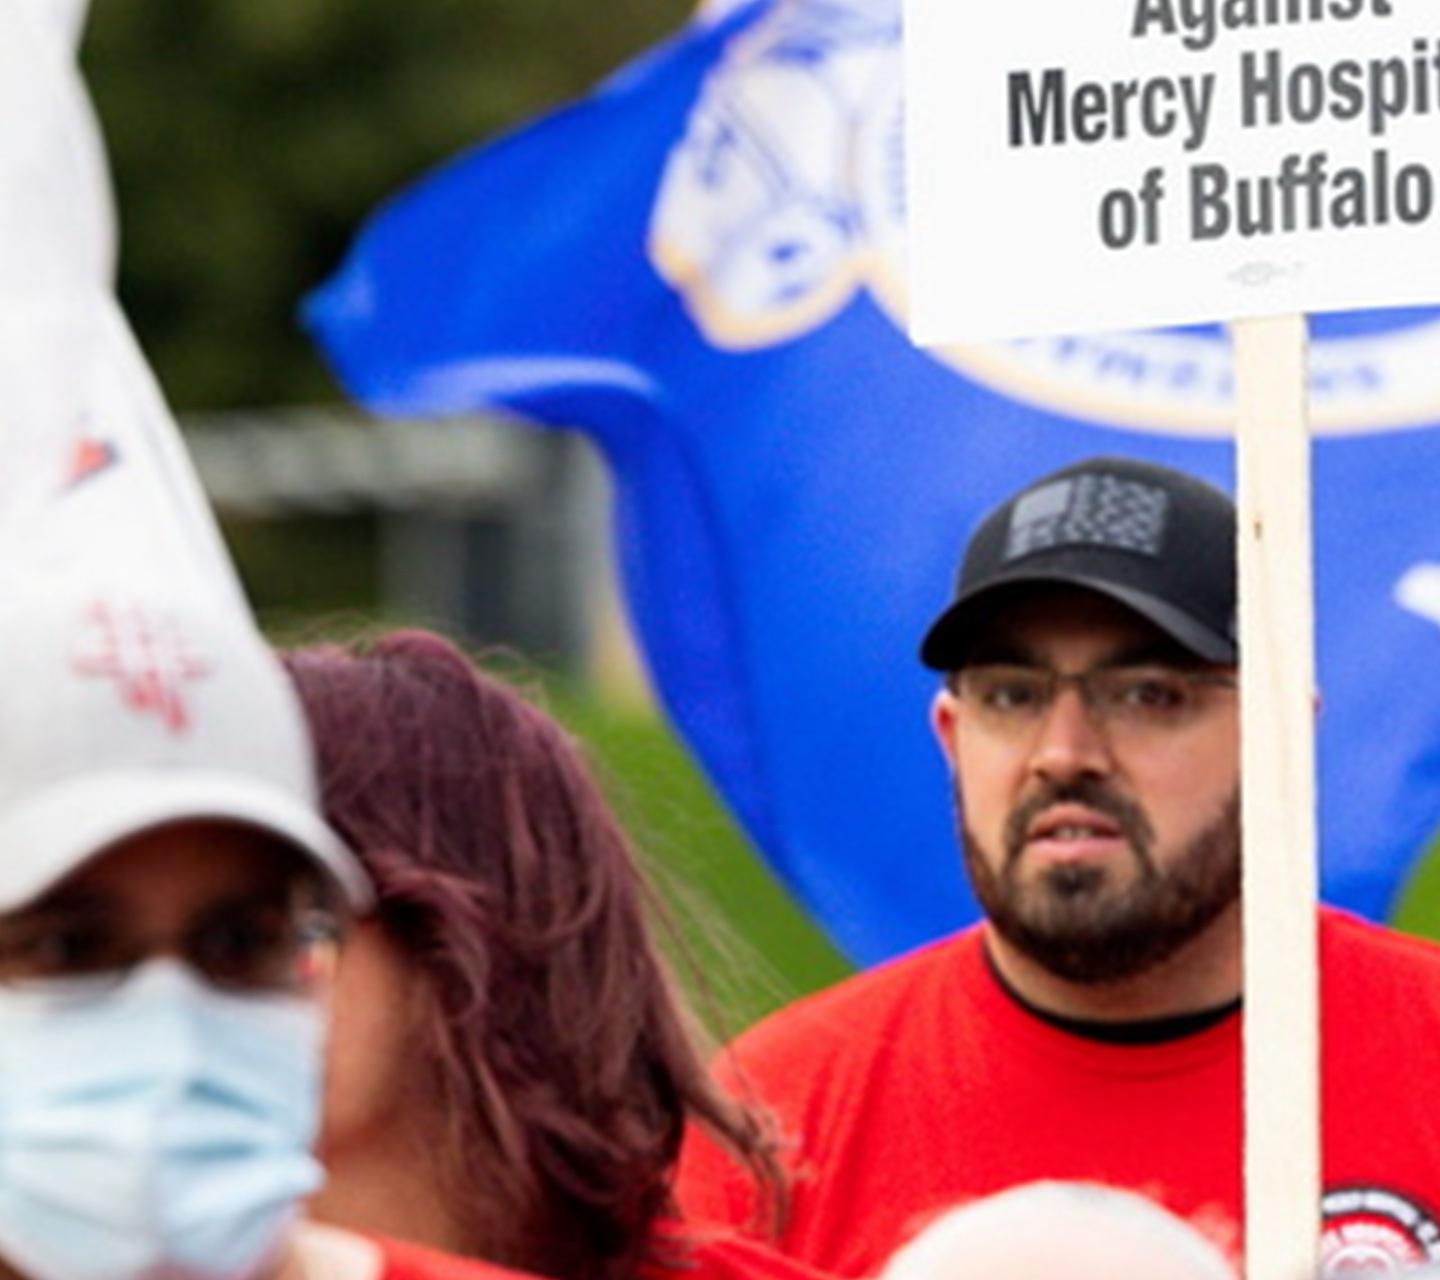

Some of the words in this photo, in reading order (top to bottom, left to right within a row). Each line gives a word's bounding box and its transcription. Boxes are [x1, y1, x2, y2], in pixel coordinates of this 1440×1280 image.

[1007, 66, 1216, 152] Mercy
[1098, 169, 1163, 250] of
[1189, 149, 1436, 242] Buffalo
